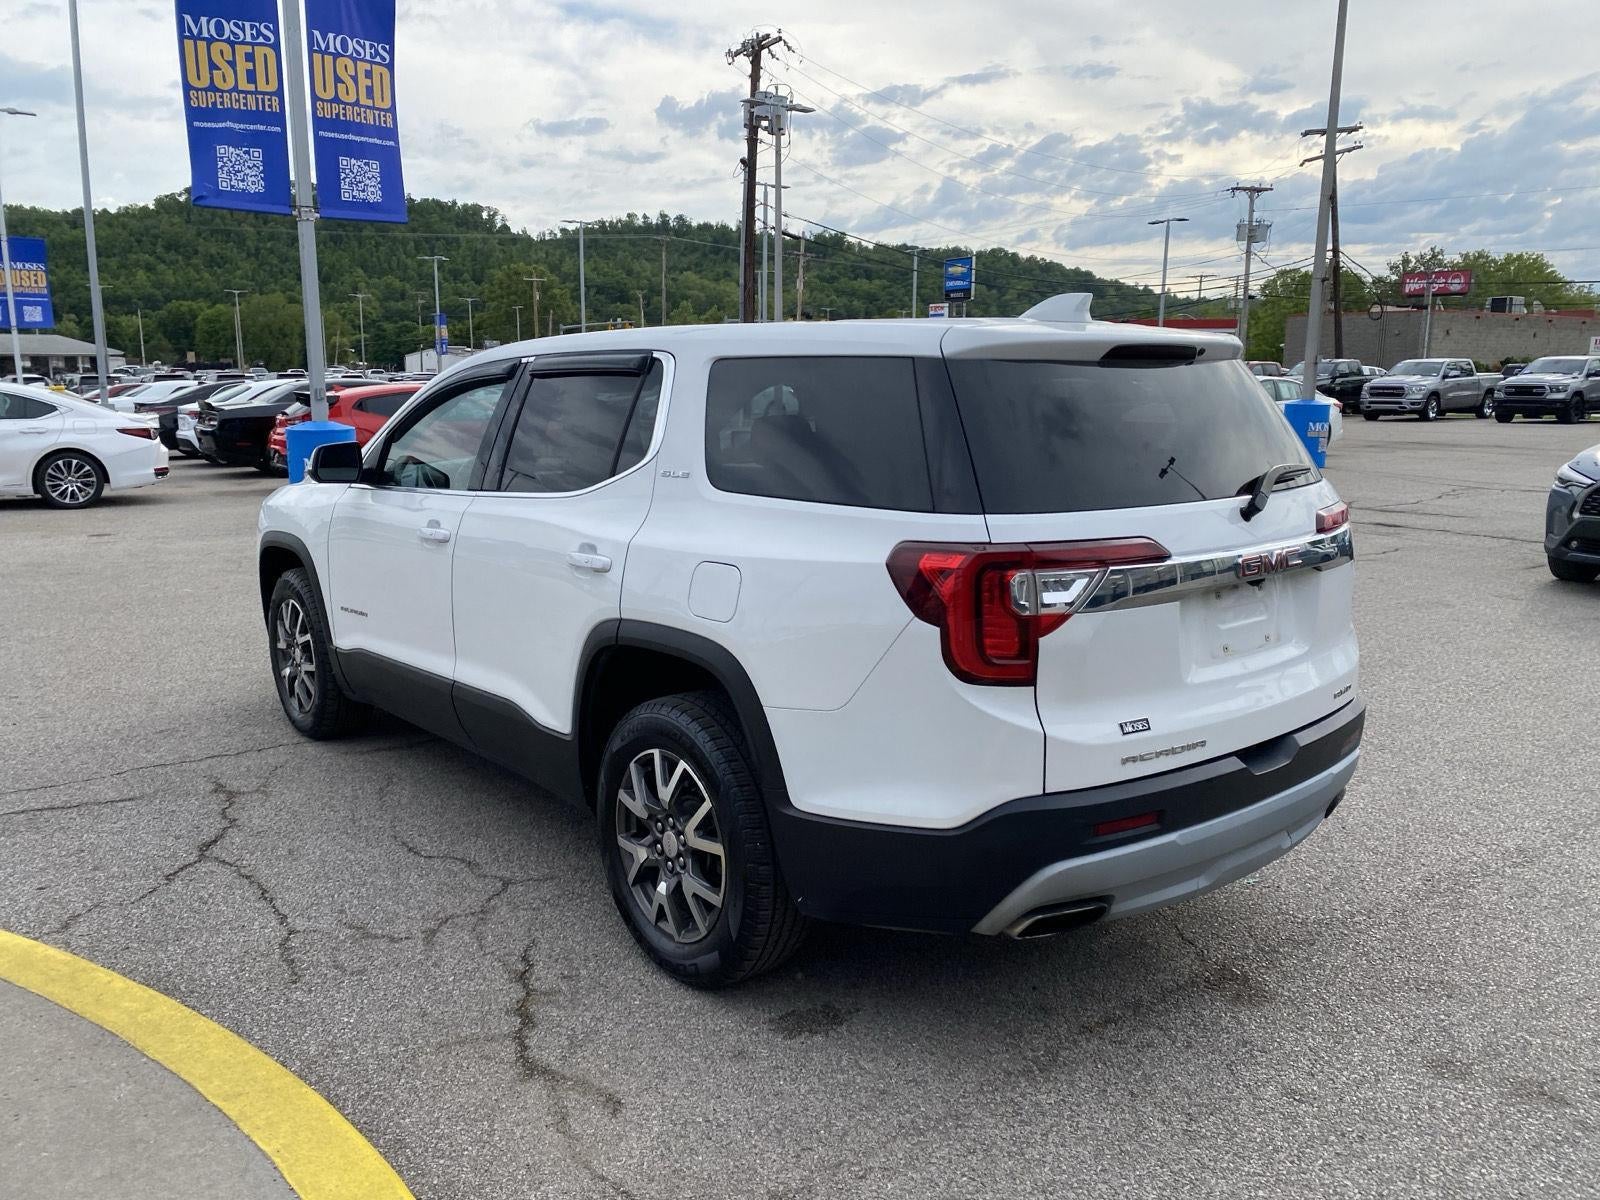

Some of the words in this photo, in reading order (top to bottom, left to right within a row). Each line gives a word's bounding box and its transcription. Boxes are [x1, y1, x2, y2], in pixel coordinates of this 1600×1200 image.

[182, 14, 275, 44] MOSES
[312, 29, 391, 64] MOSES
[184, 39, 278, 92] USED
[313, 53, 392, 109] USED
[189, 90, 280, 113] SUPERCENTER
[316, 101, 394, 129] SUPERCENTER
[11, 262, 45, 270] MOSES
[12, 270, 46, 287] USED
[1240, 546, 1303, 577] GMC
[1120, 739, 1207, 766] ACADIA
